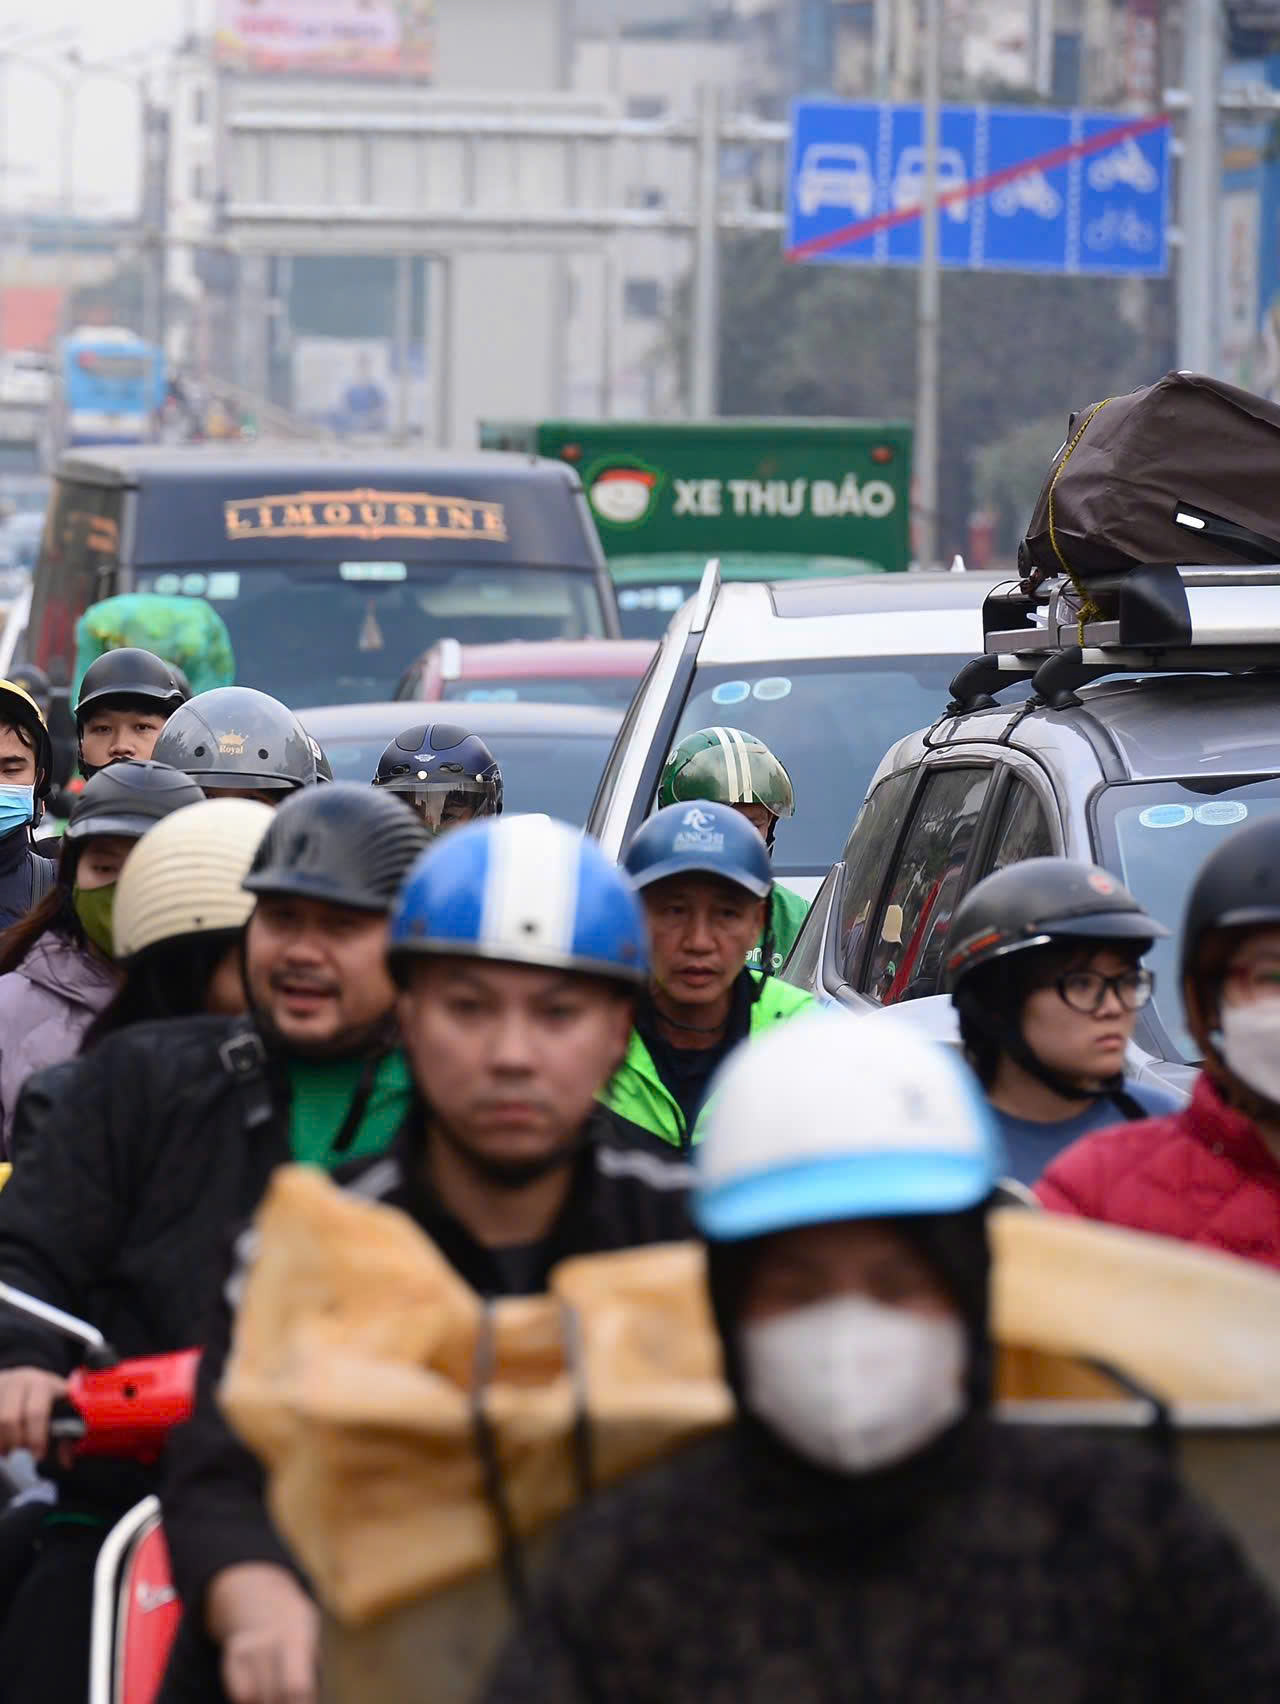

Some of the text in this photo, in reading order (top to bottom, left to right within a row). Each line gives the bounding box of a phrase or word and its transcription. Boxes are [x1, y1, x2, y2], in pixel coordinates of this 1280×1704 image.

[673, 472, 896, 518] XE THƯ BÁO
[226, 501, 507, 533] LIMOUSINE
[220, 744, 244, 755] Royal
